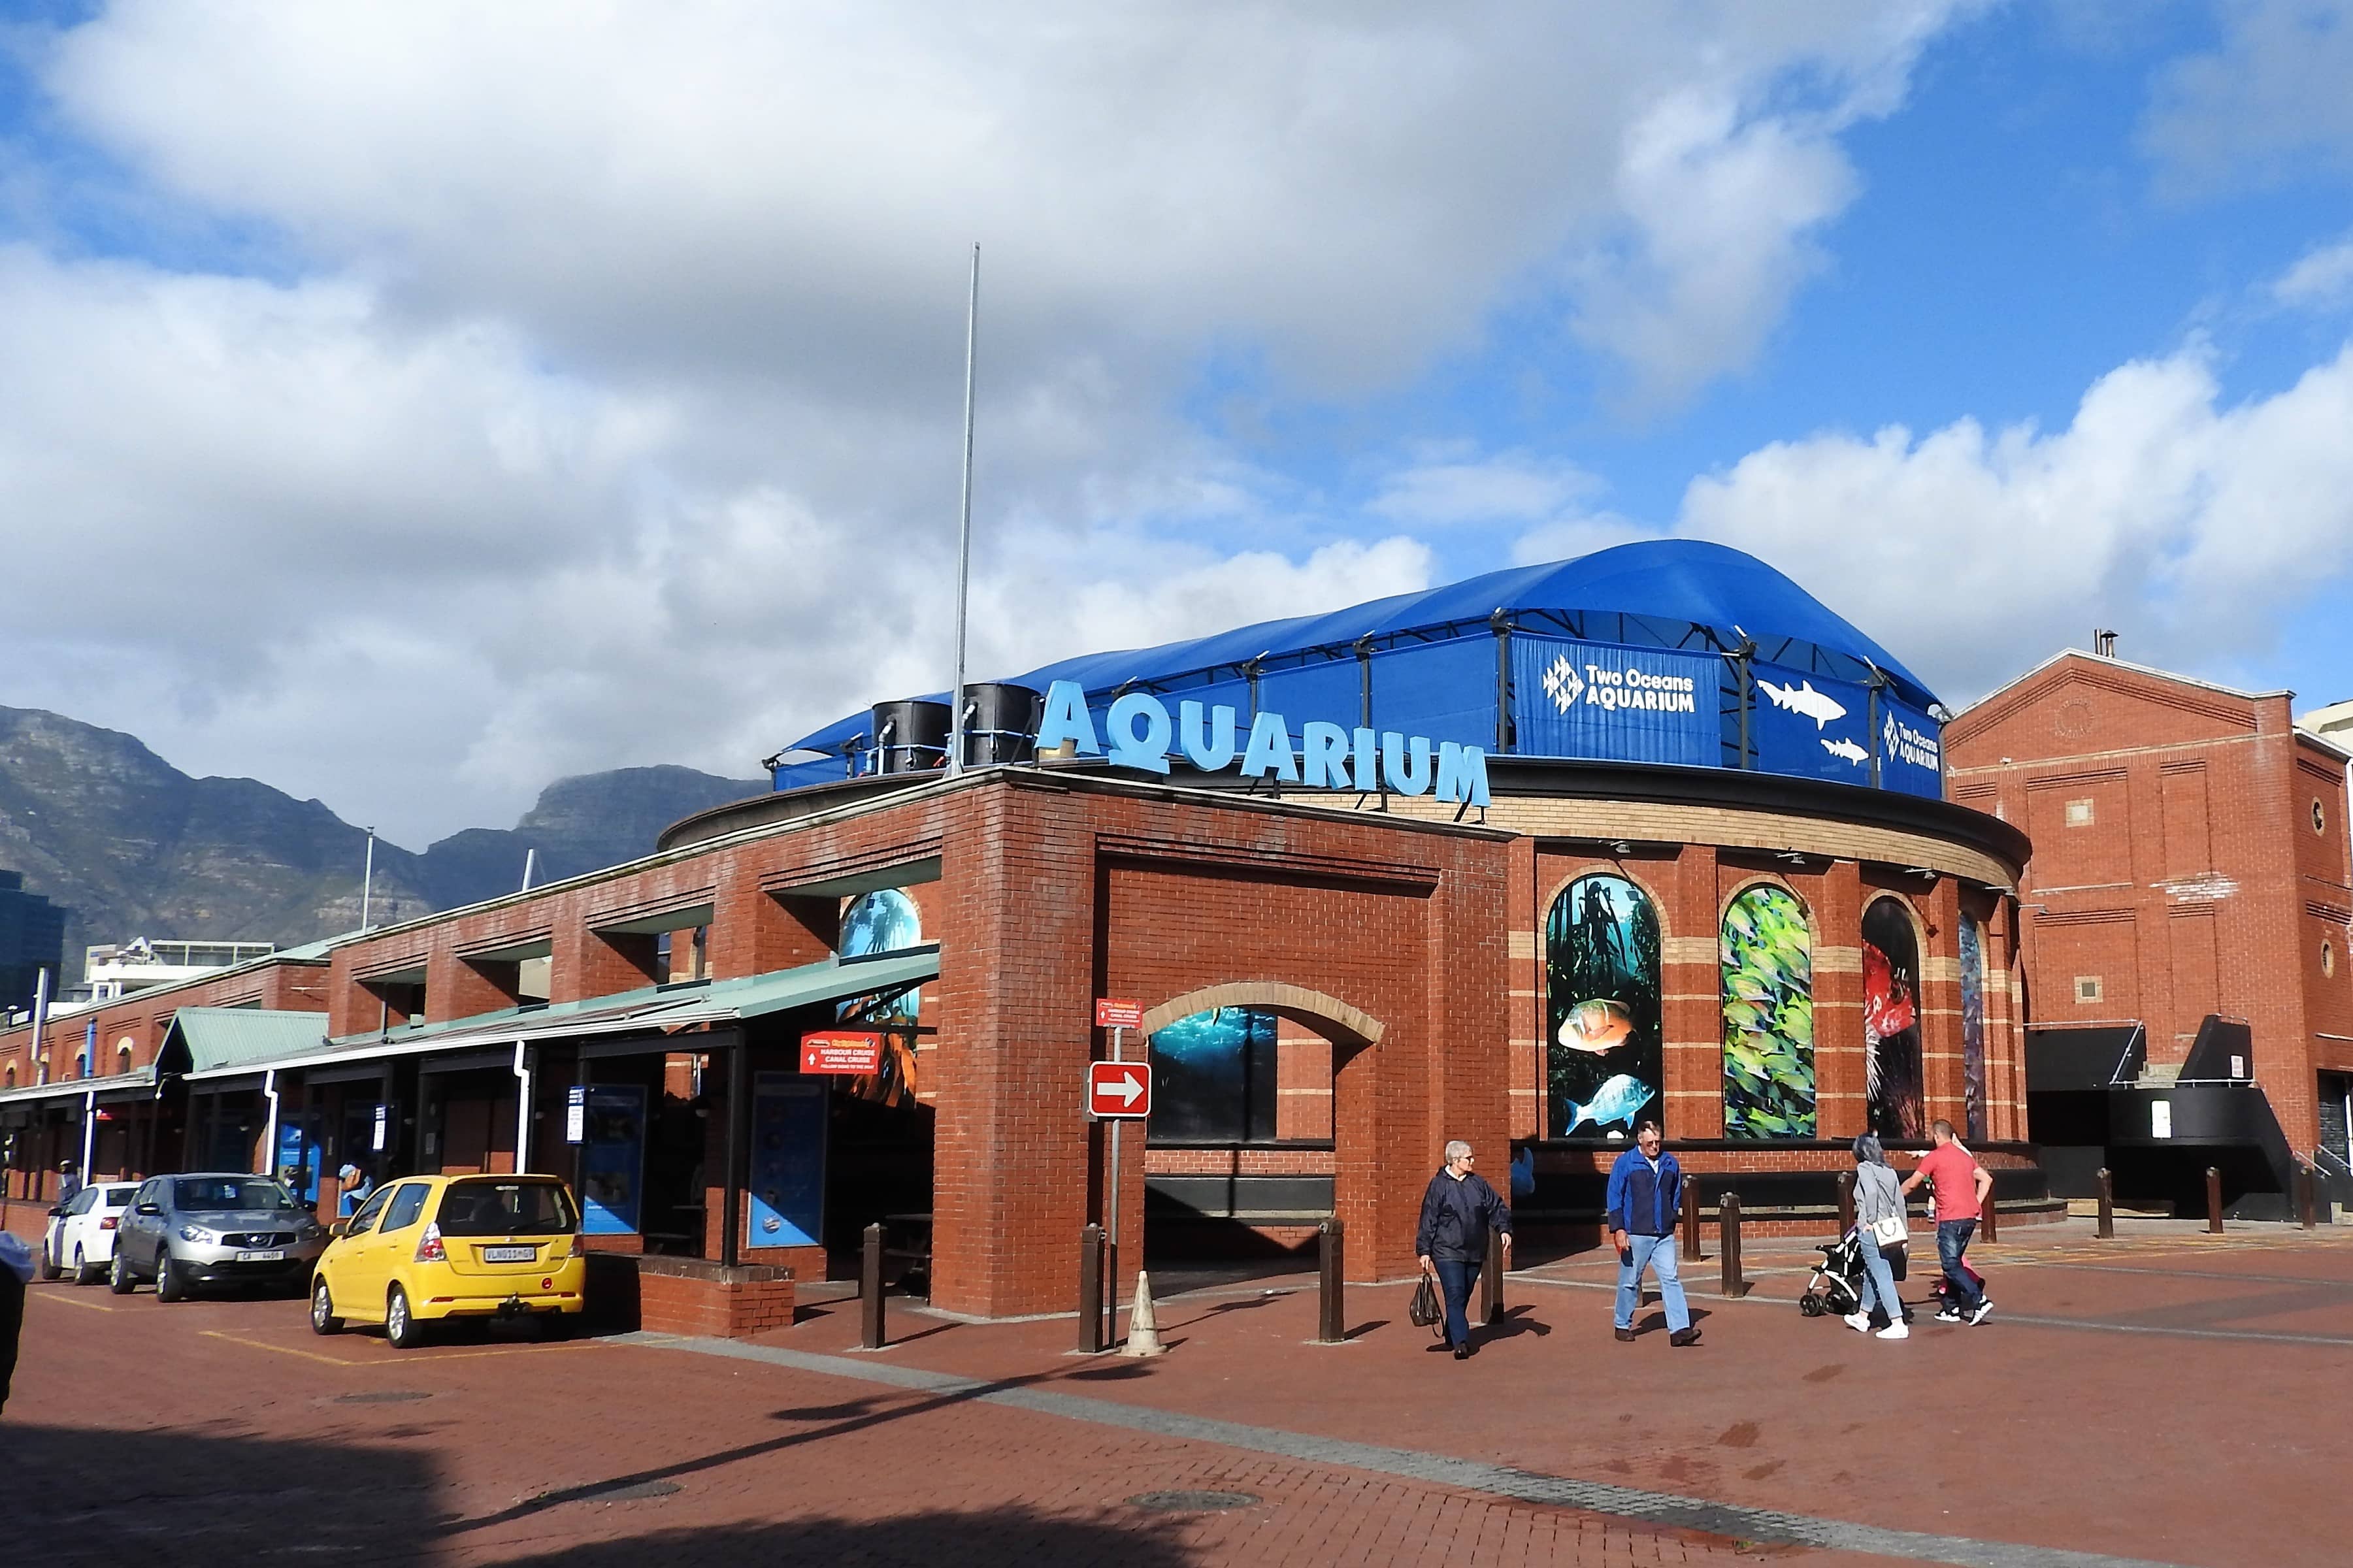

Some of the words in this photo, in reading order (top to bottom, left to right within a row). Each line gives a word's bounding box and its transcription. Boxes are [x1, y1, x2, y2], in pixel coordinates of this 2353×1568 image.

[1585, 664, 1622, 686] Two
[1626, 668, 1694, 692] Oceans
[1585, 685, 1695, 713] AQUARIUM
[1035, 680, 1490, 808] AQUARIUM
[1898, 721, 1913, 742] Two
[1913, 729, 1938, 753] Oceans
[1900, 741, 1939, 772] AQUARIUM
